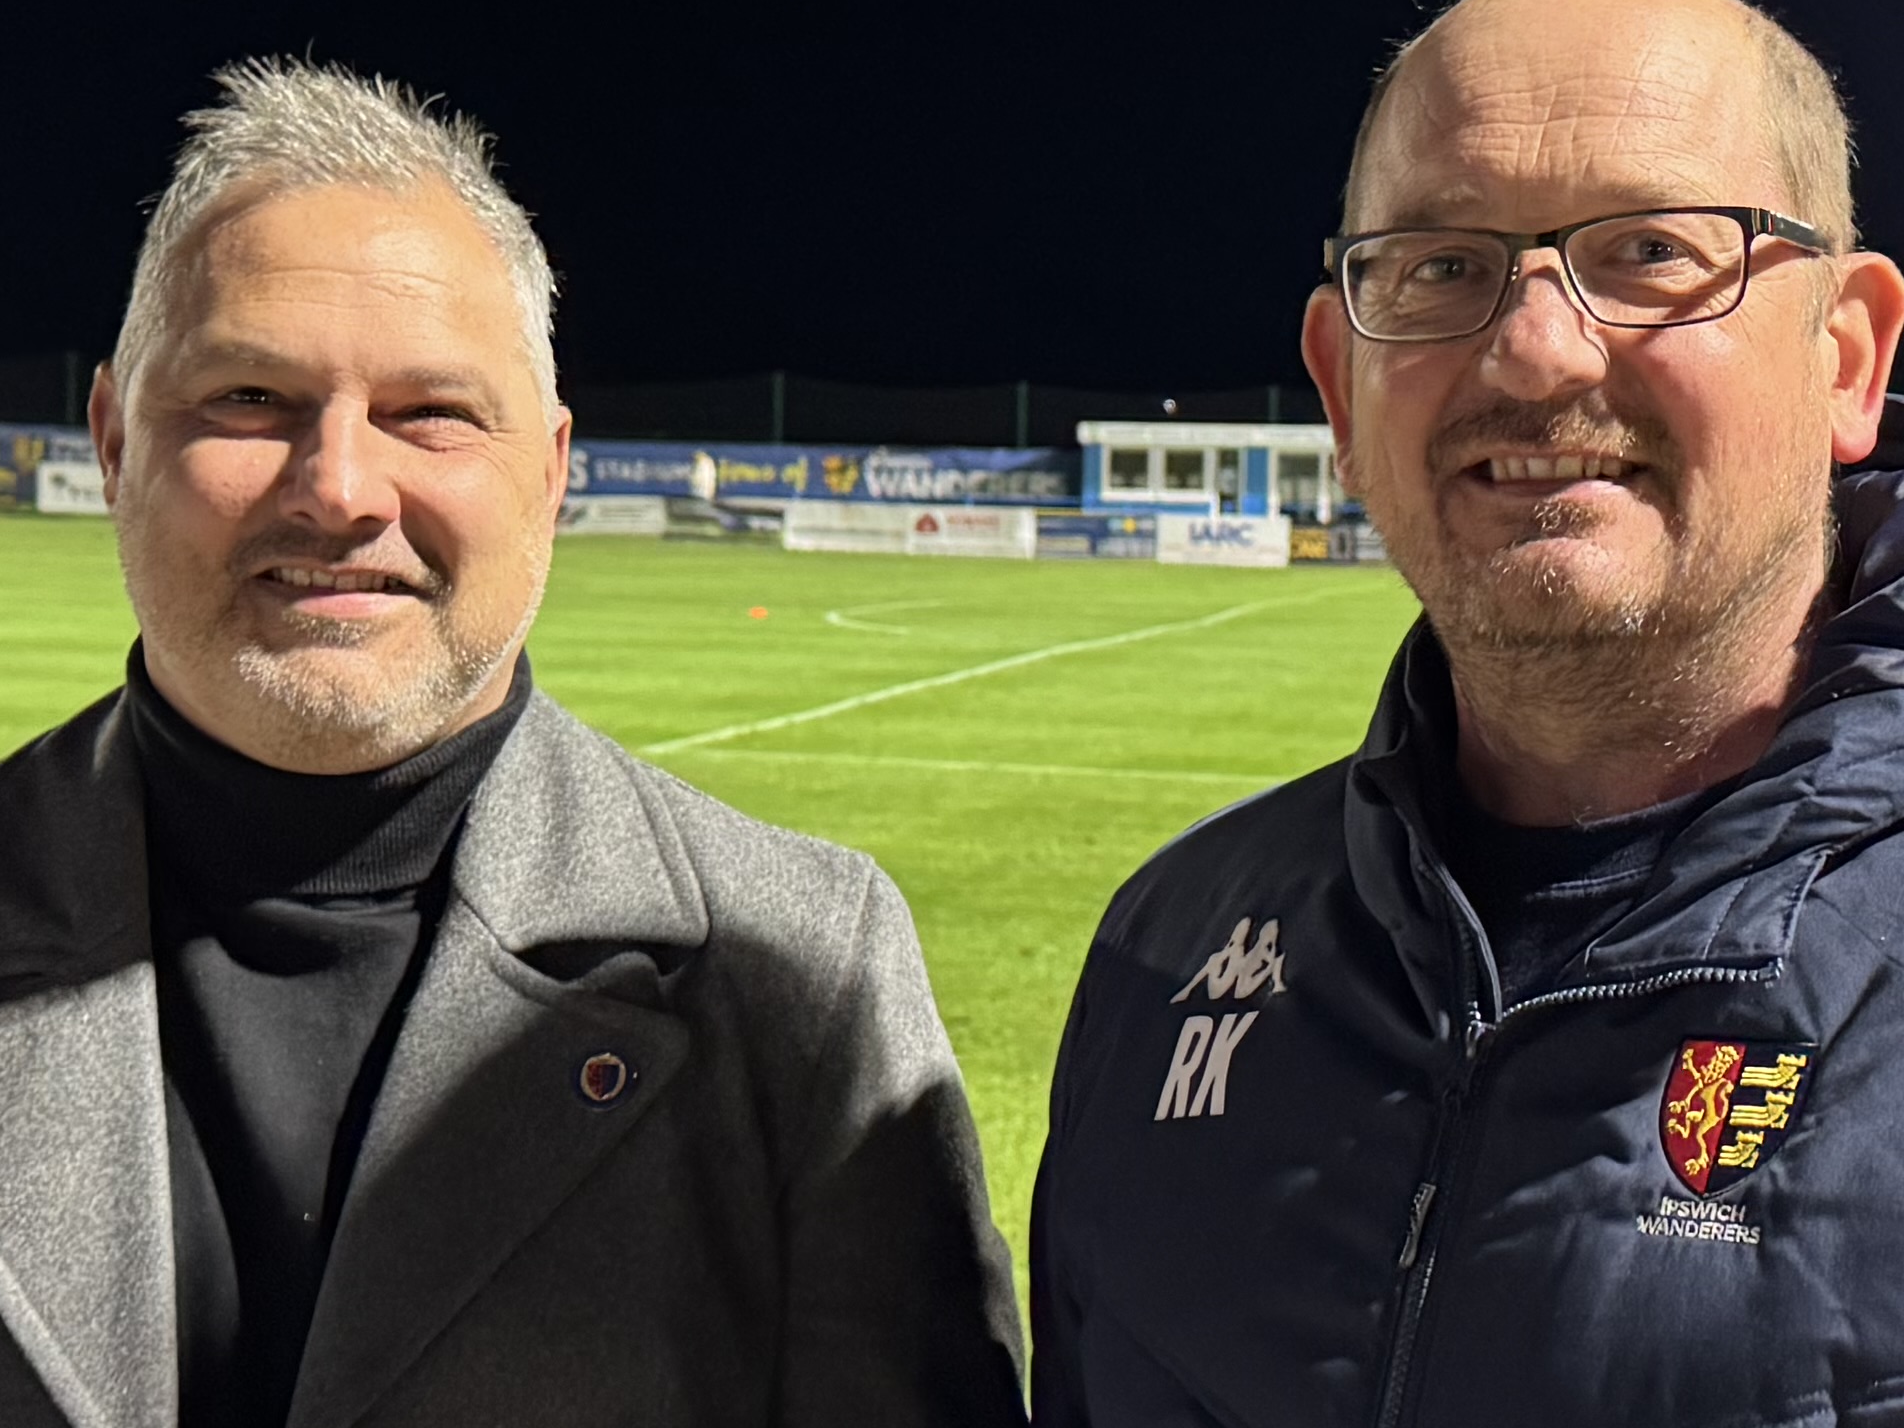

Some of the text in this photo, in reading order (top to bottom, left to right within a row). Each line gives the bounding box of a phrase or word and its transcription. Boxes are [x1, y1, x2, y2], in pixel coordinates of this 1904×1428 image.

[1154, 1010, 1259, 1121] RK
[1659, 1195, 1746, 1223] IPSWICH
[1636, 1215, 1762, 1245] WANDERERS
